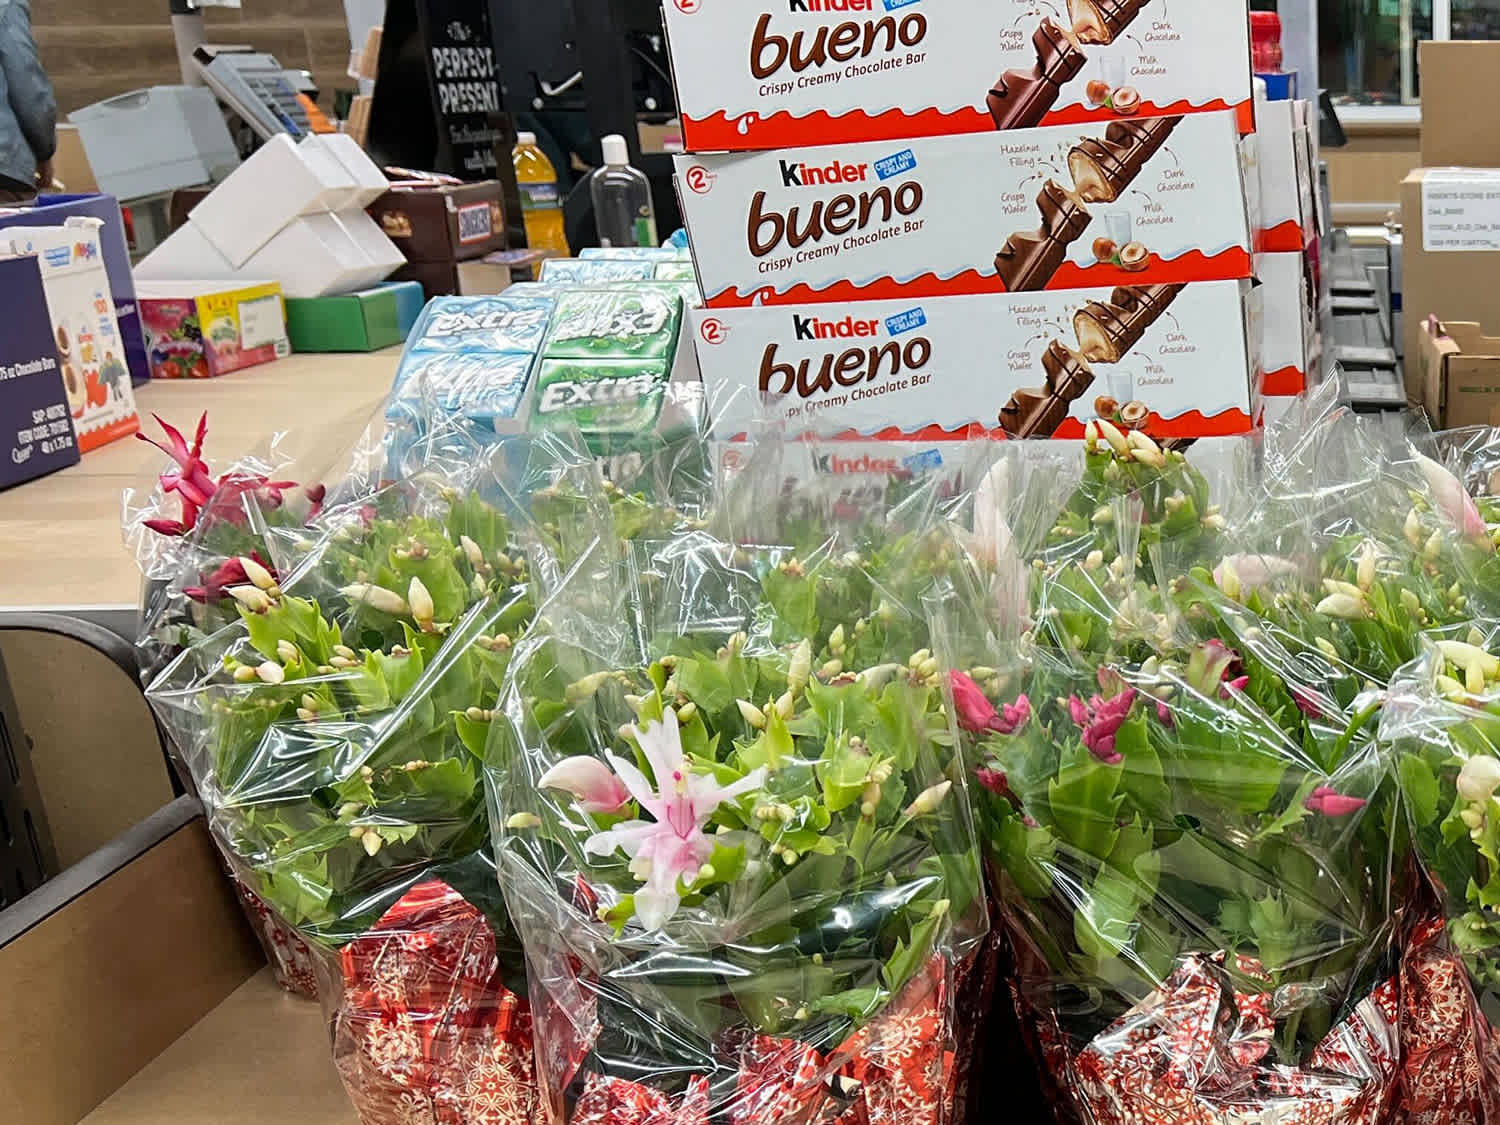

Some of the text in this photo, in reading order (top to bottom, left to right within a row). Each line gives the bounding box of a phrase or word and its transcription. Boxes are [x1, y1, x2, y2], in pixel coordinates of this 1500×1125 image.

[432, 47, 494, 79] PERFECT
[750, 13, 927, 80] bueno
[759, 52, 927, 97] Crispy Creamy Chocolate Bar
[438, 81, 499, 114] PRESENT
[690, 171, 706, 189] 2
[747, 180, 923, 257] bueno
[758, 219, 925, 273] Crispy Creamy Chocolate Bar
[704, 322, 719, 340] 2
[759, 337, 931, 405] bueno
[805, 393, 848, 412] Creamy
[851, 379, 908, 400] Chocolate
[911, 373, 932, 386] Bar
